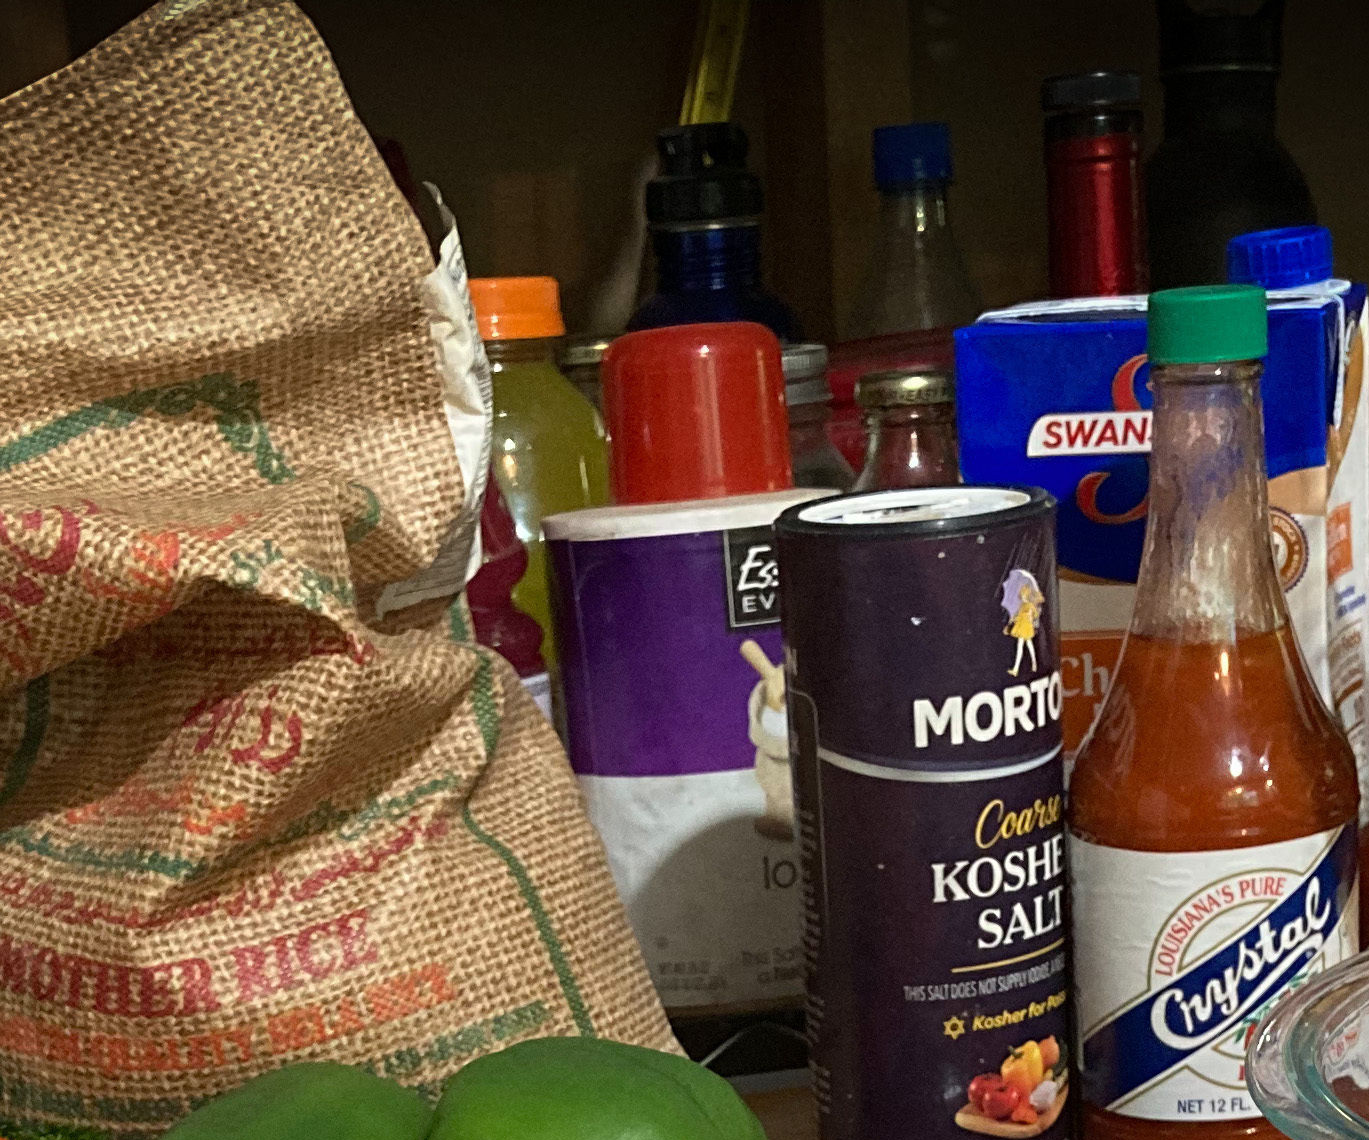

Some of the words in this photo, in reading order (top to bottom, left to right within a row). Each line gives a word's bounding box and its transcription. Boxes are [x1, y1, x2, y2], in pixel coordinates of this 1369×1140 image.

[1043, 416, 1151, 450] SWAN
[742, 592, 775, 613] EV
[913, 671, 1062, 748] MORTO
[975, 794, 1062, 849] Coarse
[931, 833, 1063, 903] KOSHE
[977, 885, 1063, 949] SALT
[1155, 882, 1235, 977] LOUISIANA'S
[1238, 876, 1286, 899] PURE
[232, 908, 378, 1003] RICE
[1150, 876, 1331, 1050] Crystal
[903, 985, 926, 1001] THIS
[928, 984, 949, 1000] SALT
[950, 981, 977, 999] DOES
[978, 976, 997, 994] NOT
[972, 1006, 1028, 1031] Kosher
[1028, 1001, 1046, 1019] for
[1177, 1099, 1203, 1113] NET
[1209, 1098, 1227, 1113] 12
[1231, 1098, 1252, 1112] FL.
